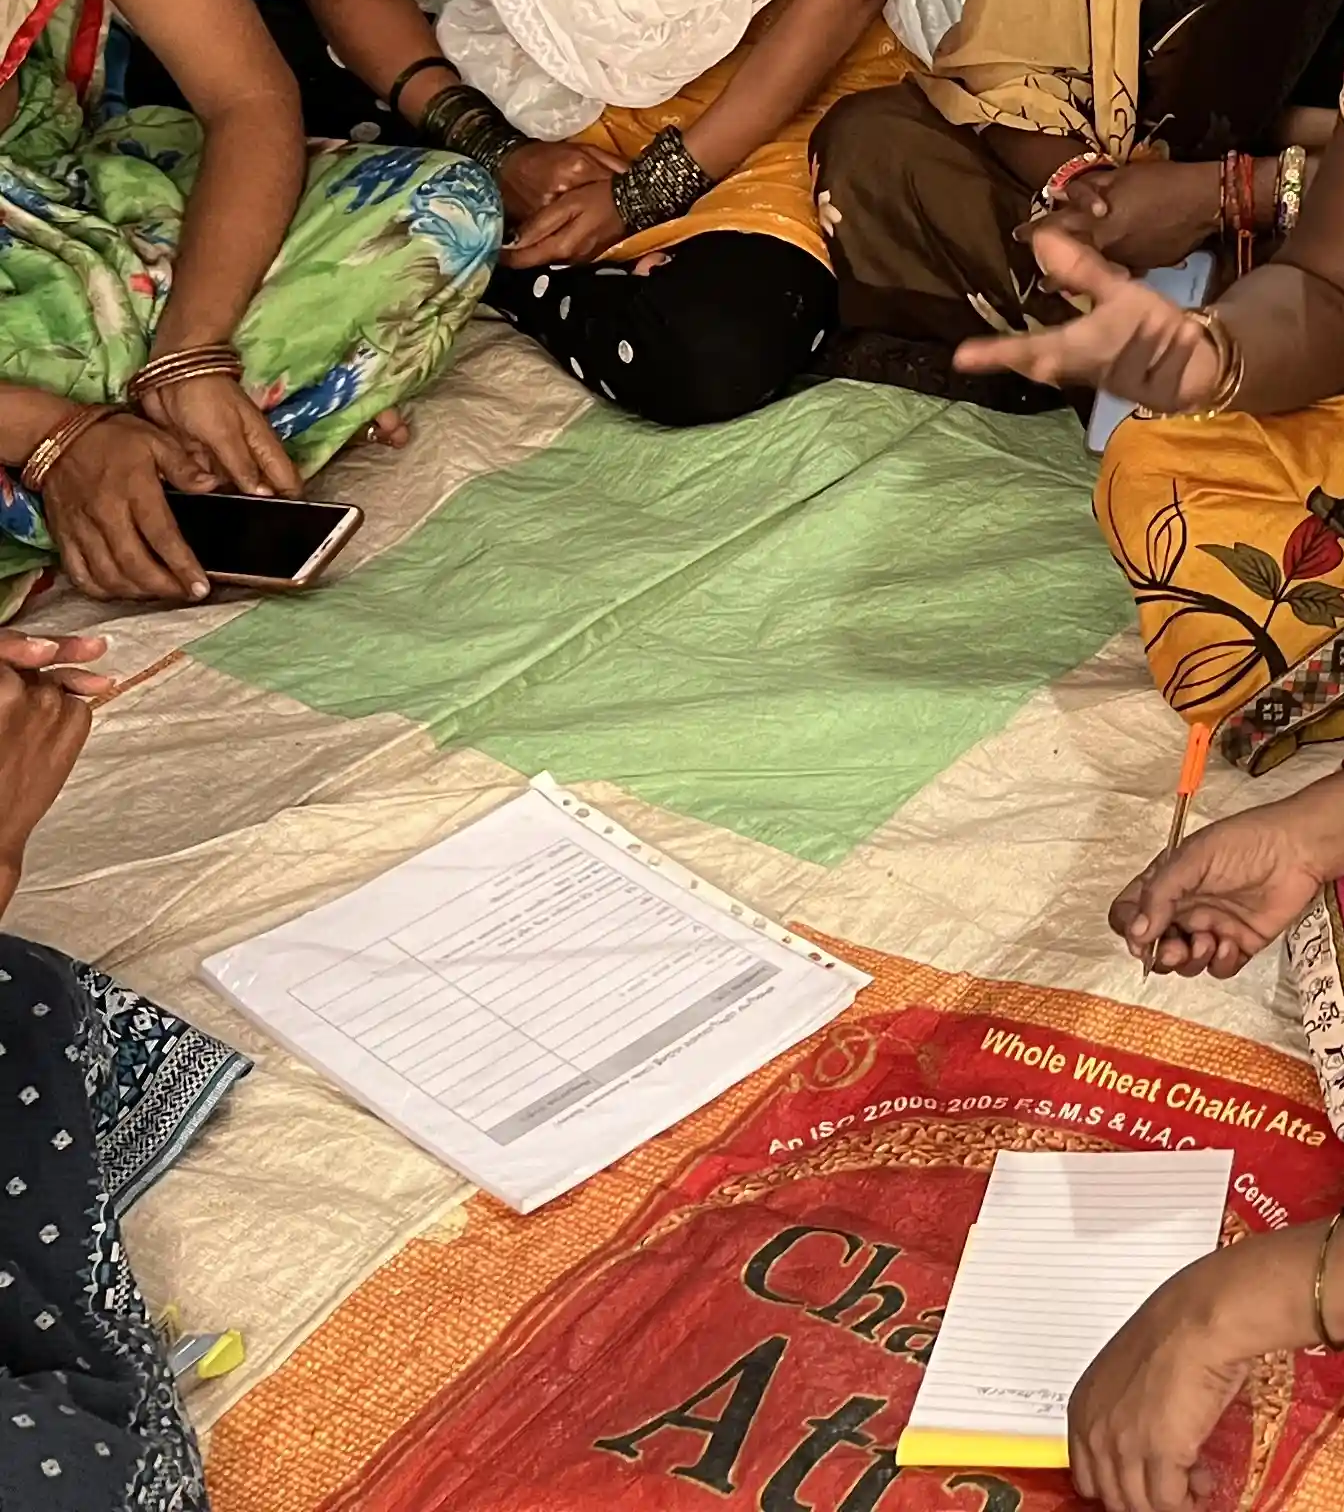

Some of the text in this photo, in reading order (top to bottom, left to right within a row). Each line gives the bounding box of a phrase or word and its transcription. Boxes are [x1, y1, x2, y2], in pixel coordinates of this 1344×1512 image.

[980, 1027, 1328, 1148] Whole Wheat Chakki Atta
[768, 1137, 804, 1156] An
[1107, 1112, 1127, 1132] &
